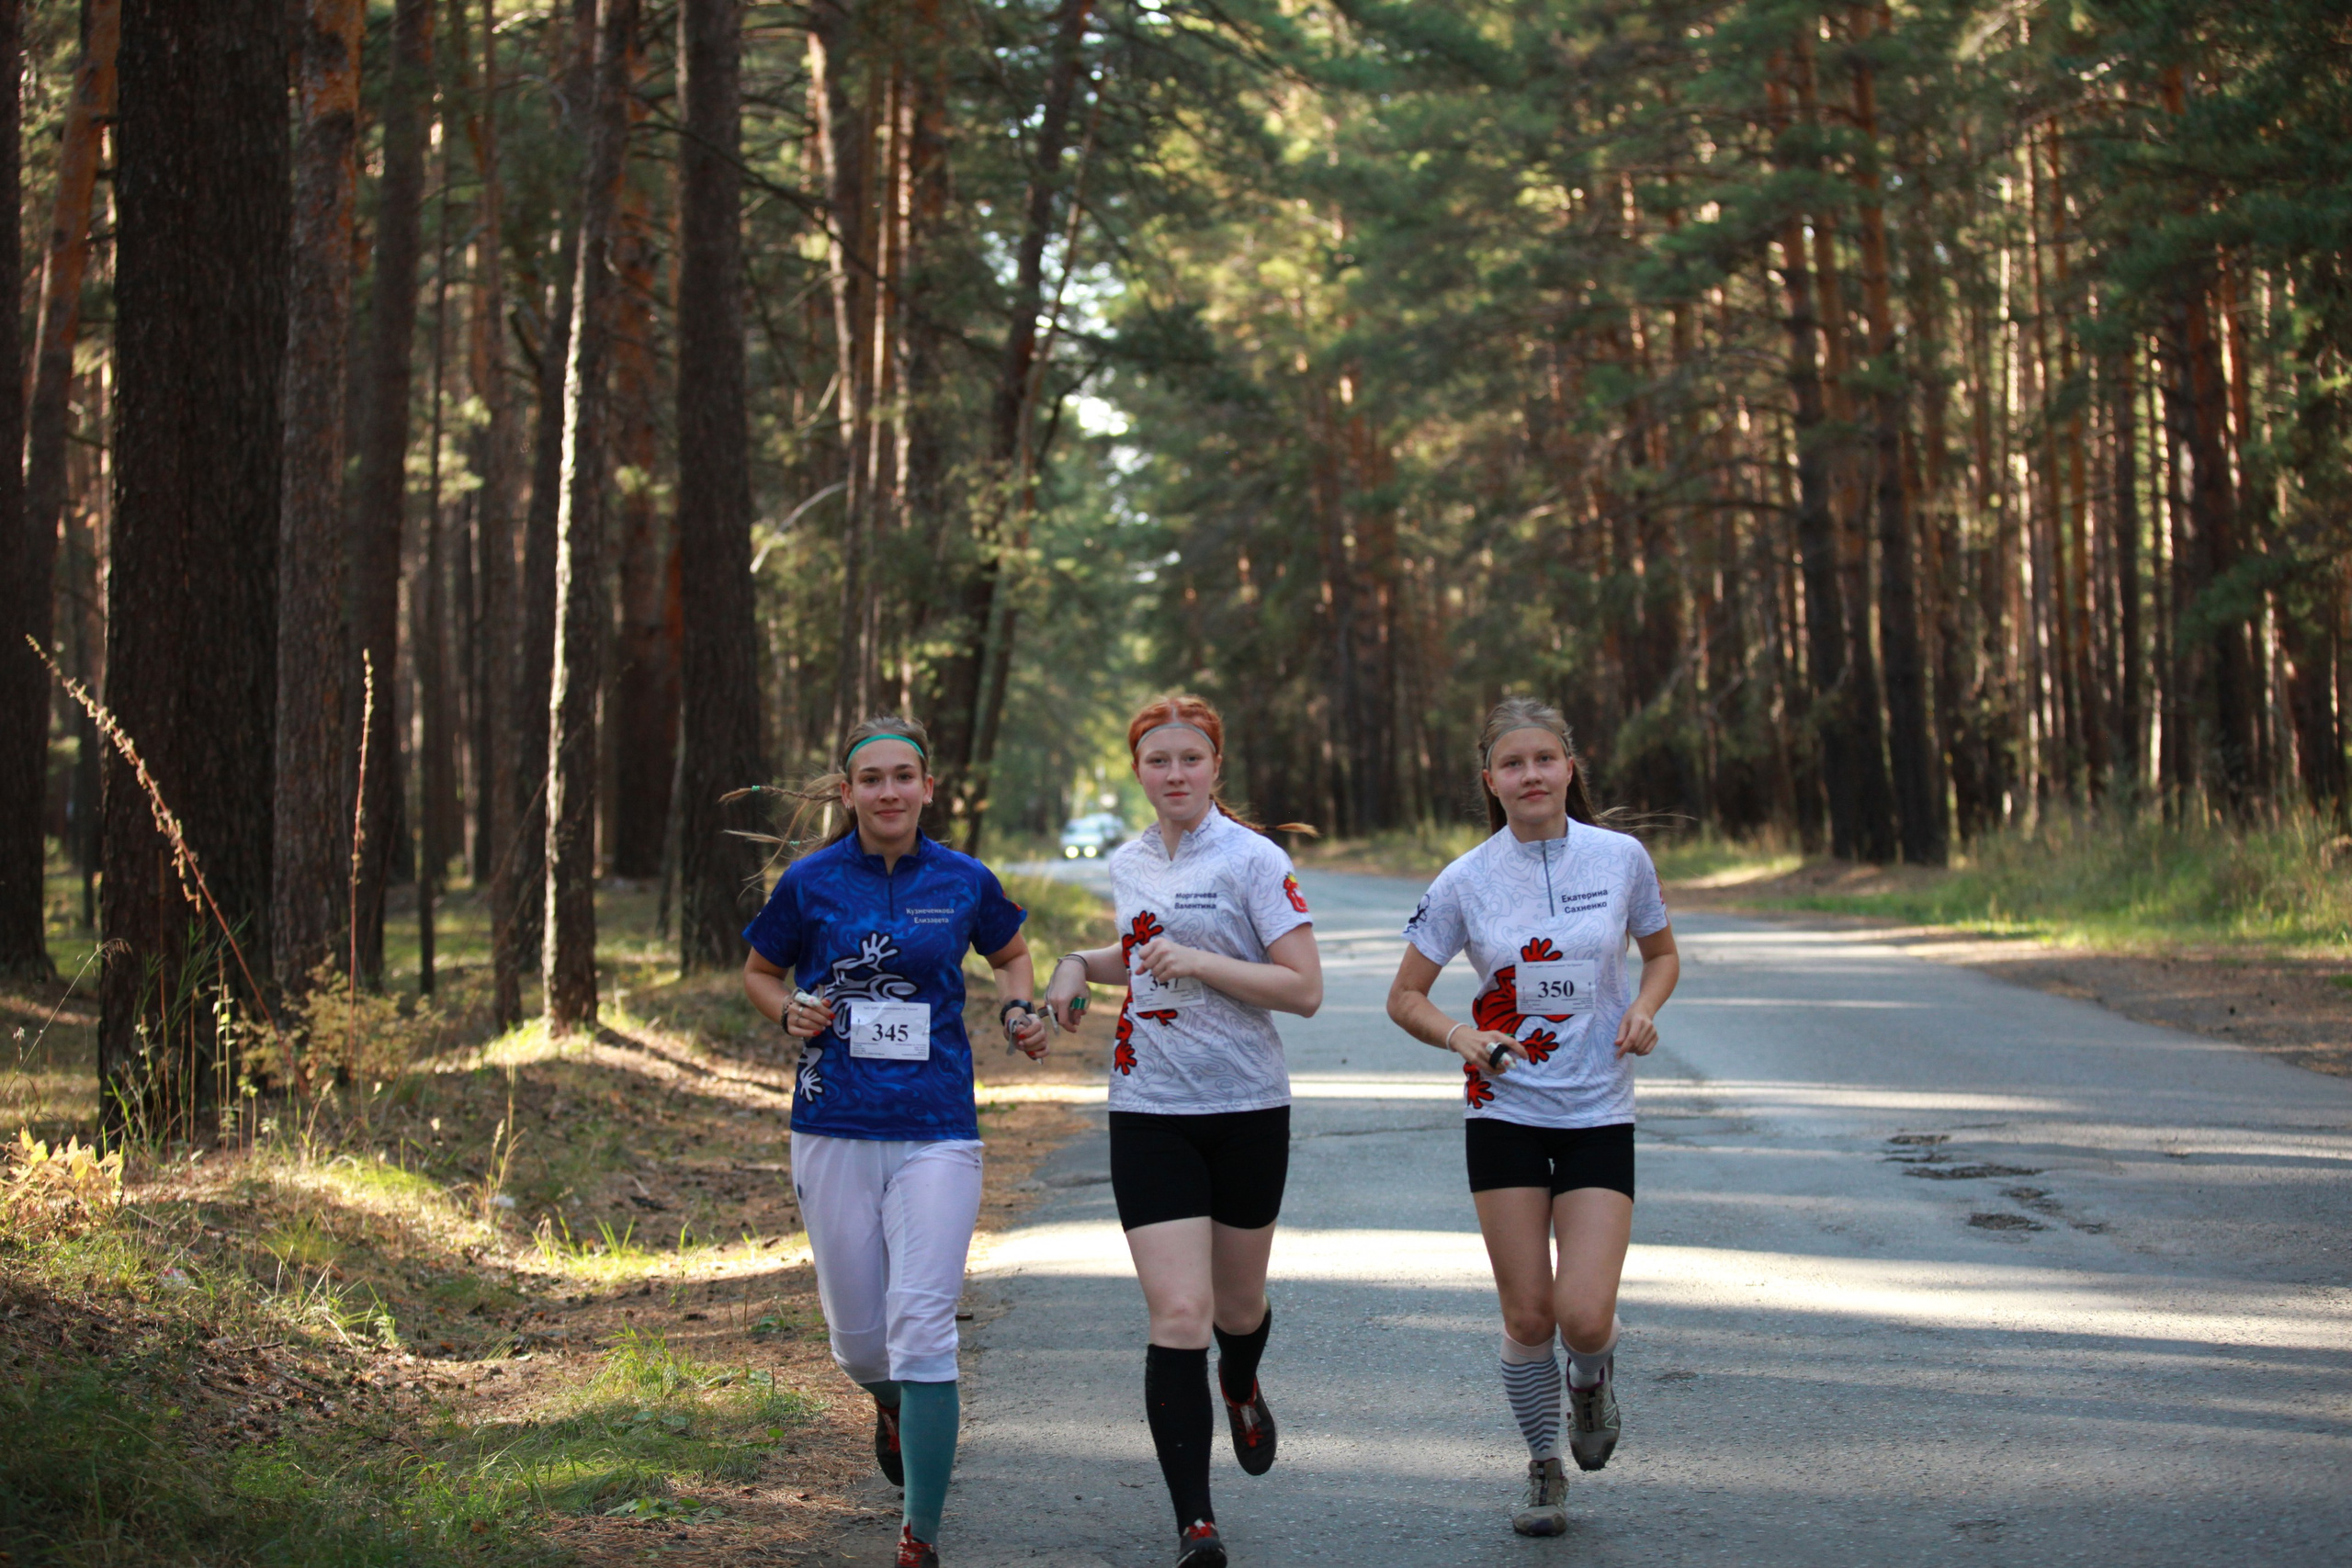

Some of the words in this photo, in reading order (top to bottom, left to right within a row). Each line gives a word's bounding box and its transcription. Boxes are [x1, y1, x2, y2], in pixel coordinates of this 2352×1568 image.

[1562, 889, 1609, 903] Екатерина
[1564, 901, 1608, 914] Сахненко
[1537, 979, 1575, 998] 350
[871, 1023, 909, 1043] 345
